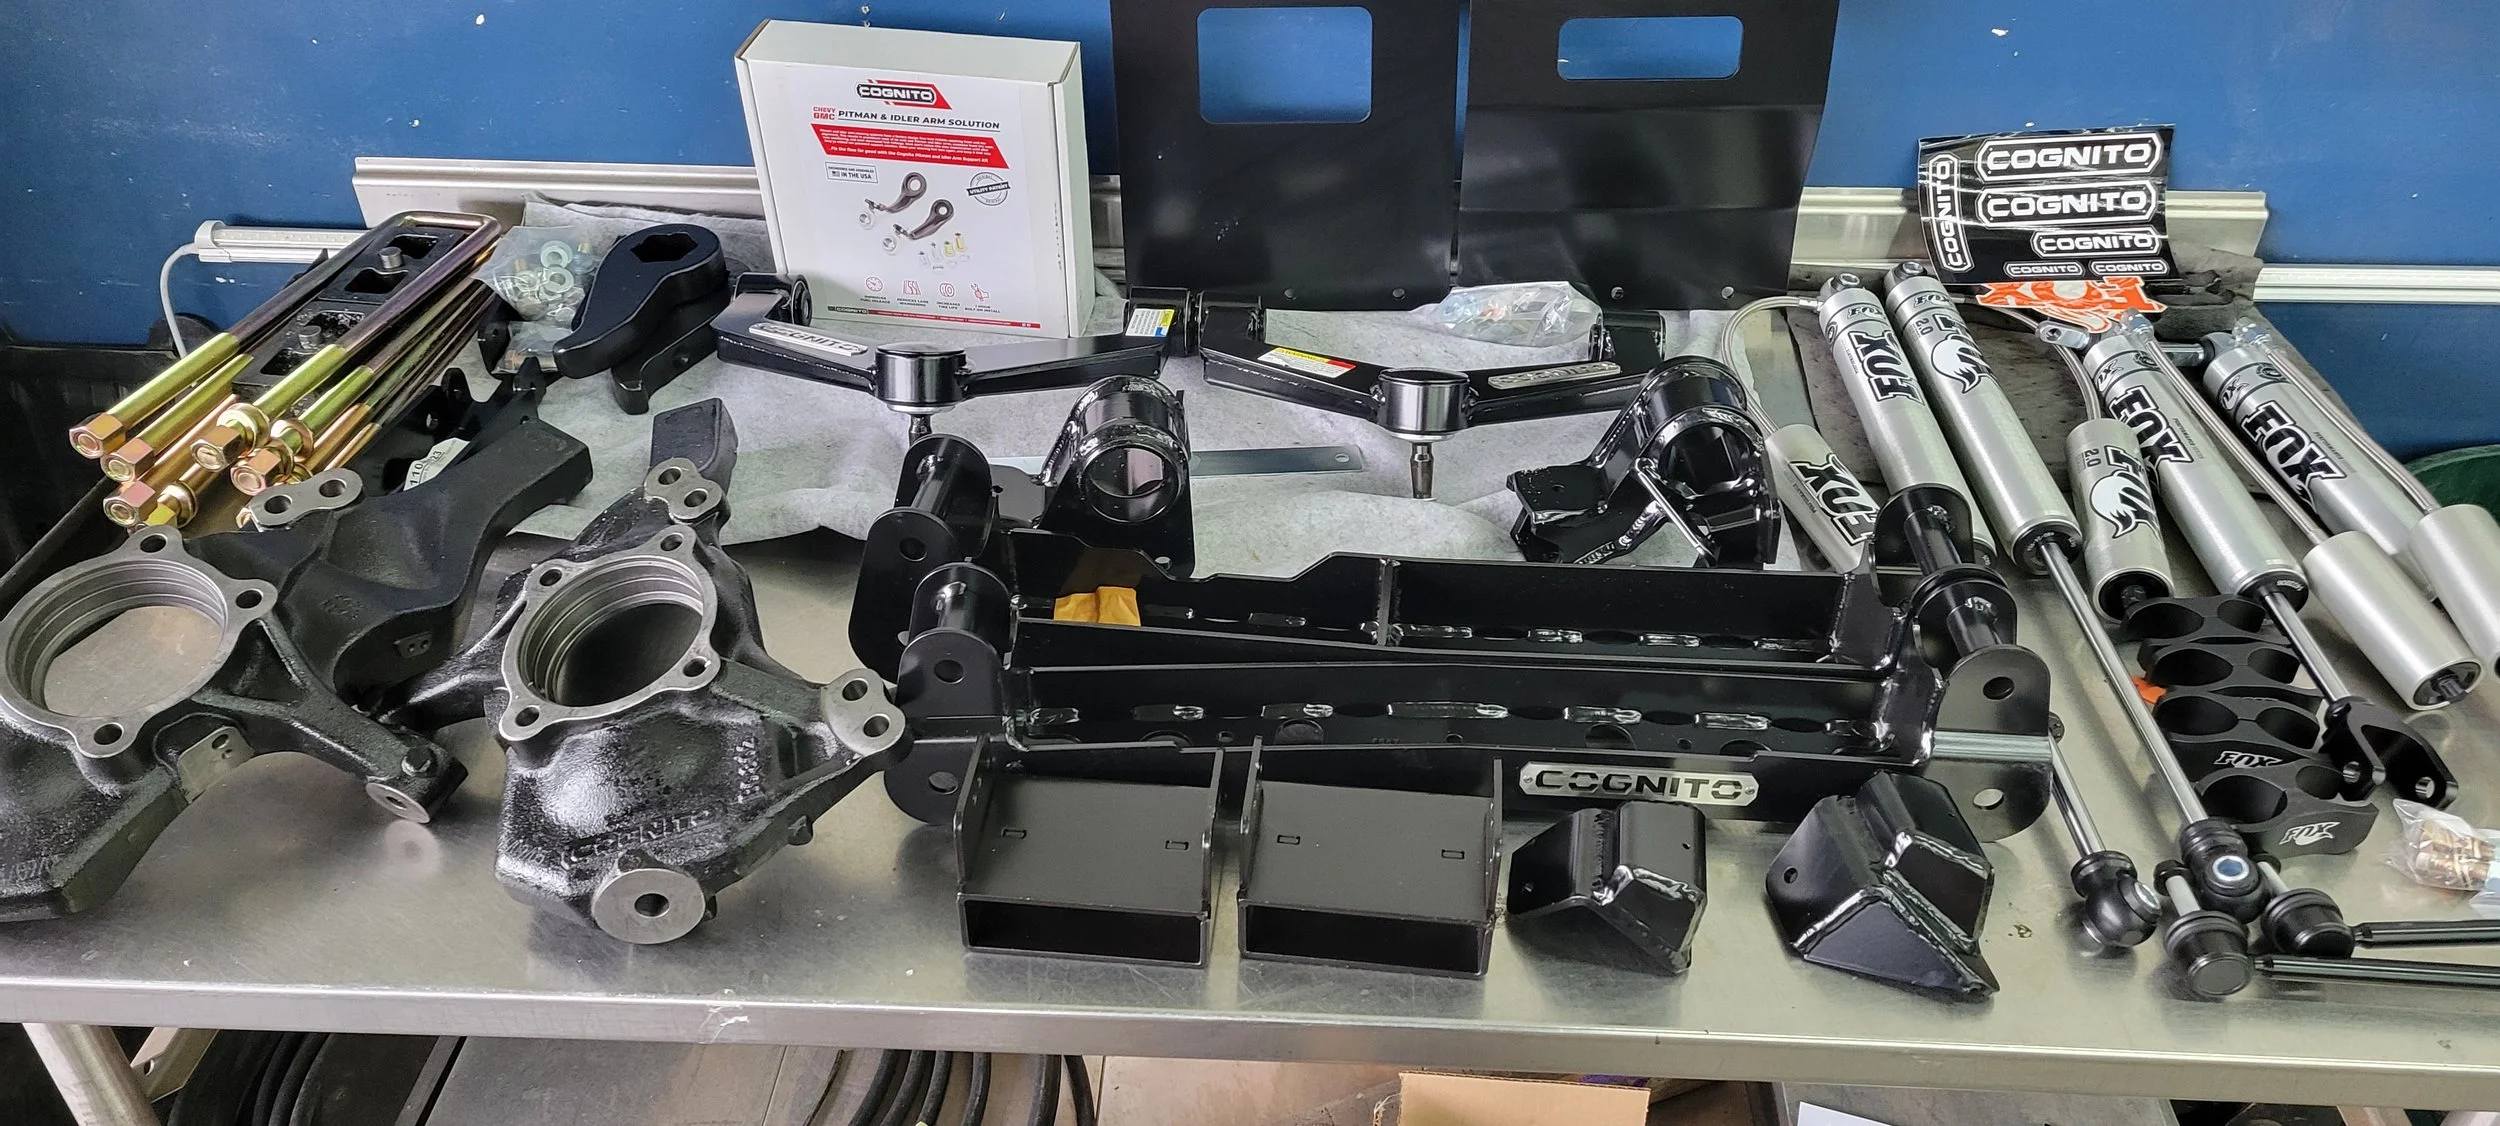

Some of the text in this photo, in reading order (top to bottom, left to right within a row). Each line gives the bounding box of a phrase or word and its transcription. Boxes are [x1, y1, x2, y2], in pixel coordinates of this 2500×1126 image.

[859, 86, 933, 101] COGNITO
[838, 110, 1000, 129] PITMAN & IDLER ARM SOLUTION
[1987, 143, 2151, 171] COGNITO
[1936, 161, 1963, 267] COGNITO
[1987, 190, 2148, 217] COGNITO
[2039, 233, 2152, 253] COGNITO
[2011, 263, 2079, 275] COGNITO
[2096, 261, 2165, 273] COGNITO
[758, 324, 862, 352] COGNITO
[1915, 317, 1934, 336] 2.0
[1848, 330, 1923, 405] FOX
[2108, 385, 2195, 464] FOX
[2084, 448, 2102, 468] 2.0
[2241, 400, 2348, 492] FOX
[1788, 452, 1880, 546] FOX
[2214, 750, 2283, 768] FOX
[1535, 770, 1743, 800] COGNITO
[2278, 821, 2341, 847] FOX
